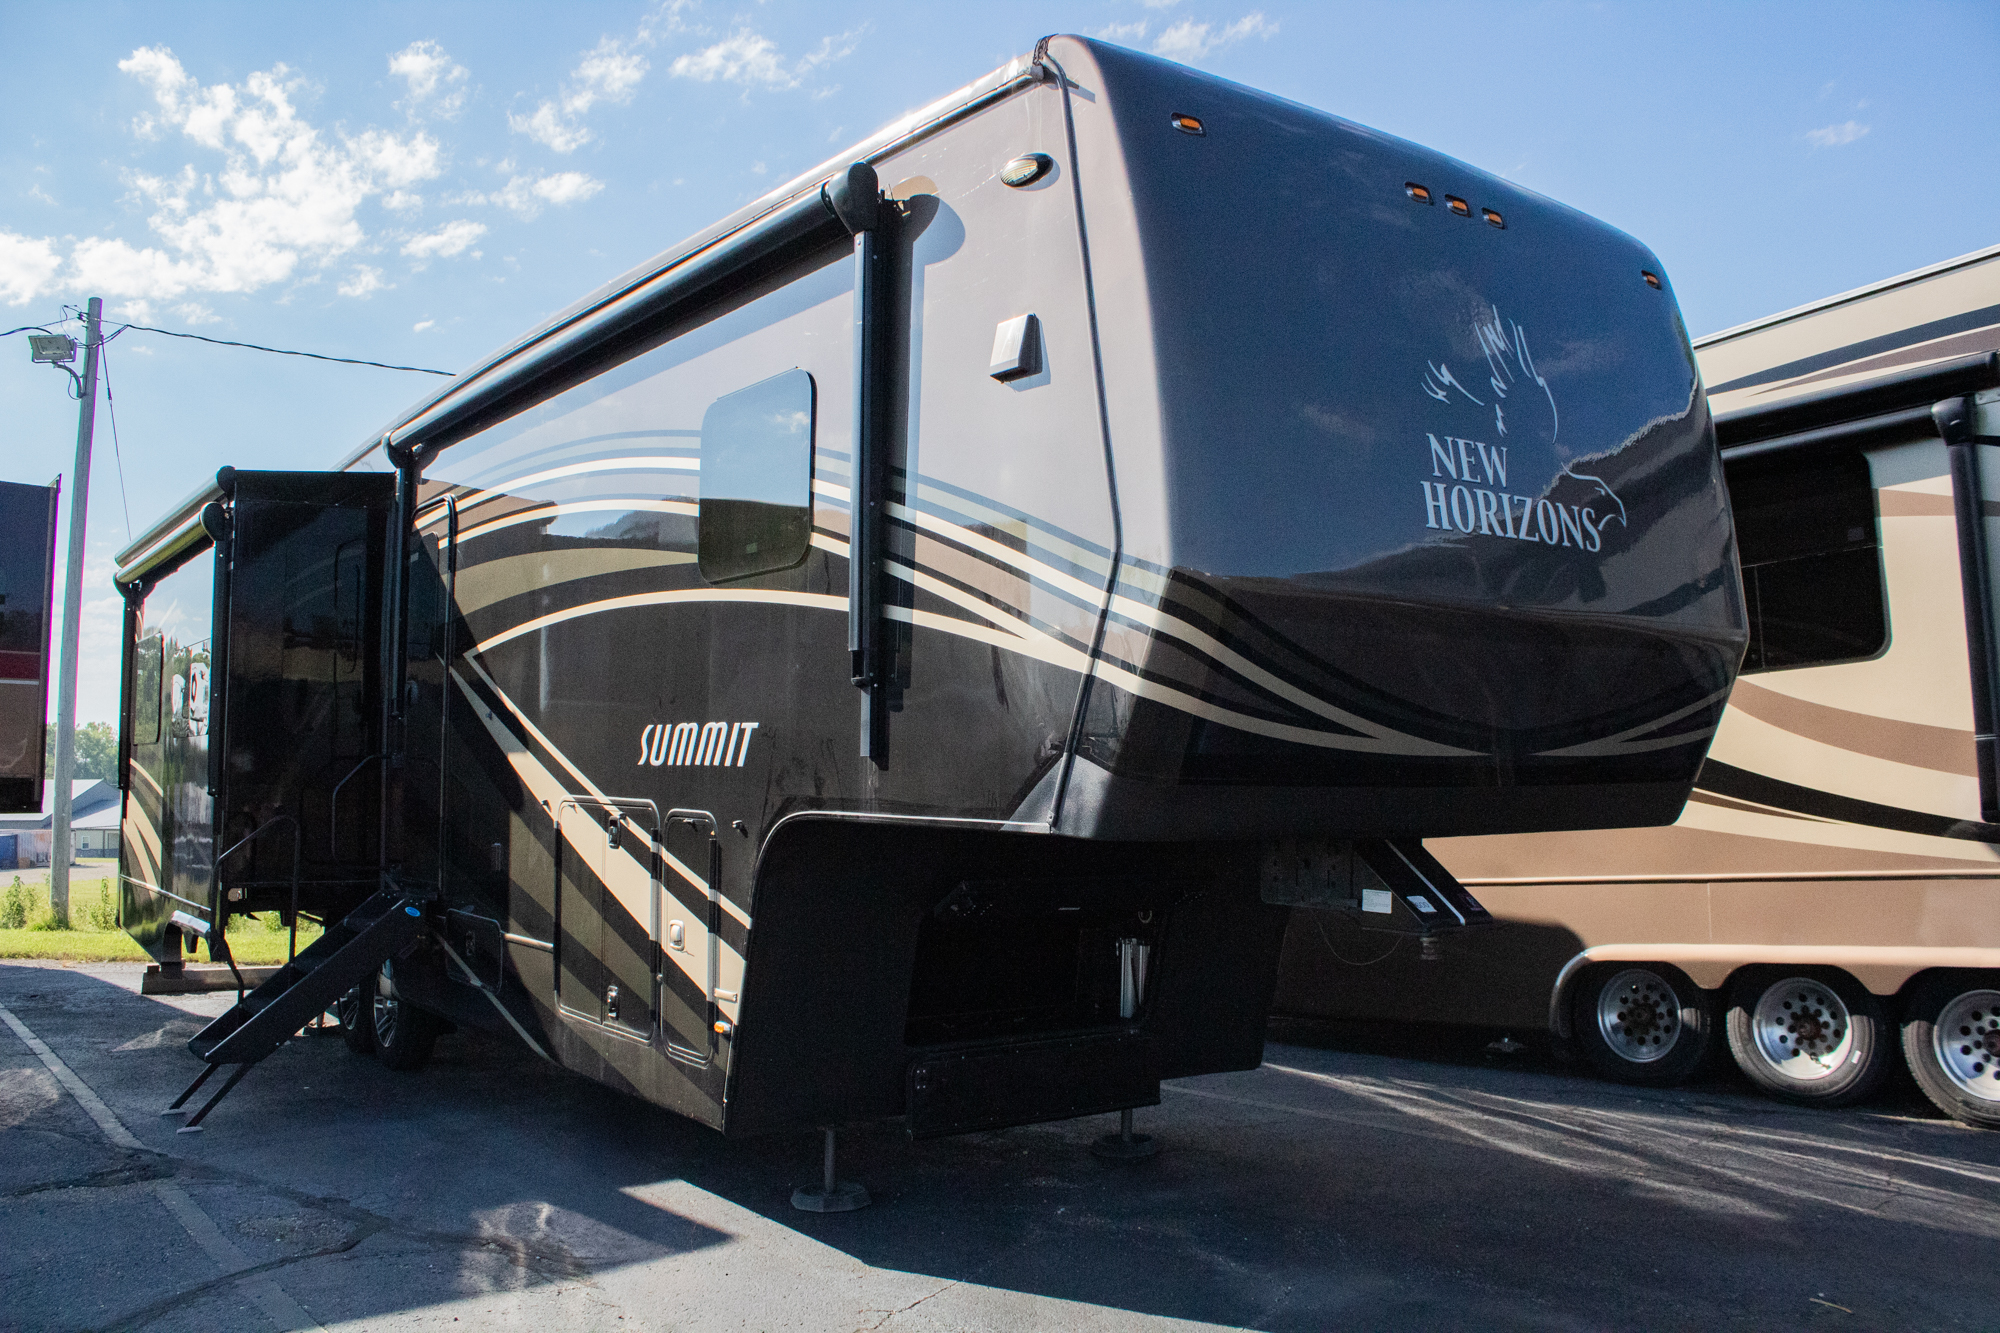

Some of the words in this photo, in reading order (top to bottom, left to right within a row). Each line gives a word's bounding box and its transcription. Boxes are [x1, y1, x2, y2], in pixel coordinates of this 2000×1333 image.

[1426, 433, 1508, 488] NEW
[1420, 481, 1601, 552] HORIZONS
[637, 721, 759, 767] SUMMIT
